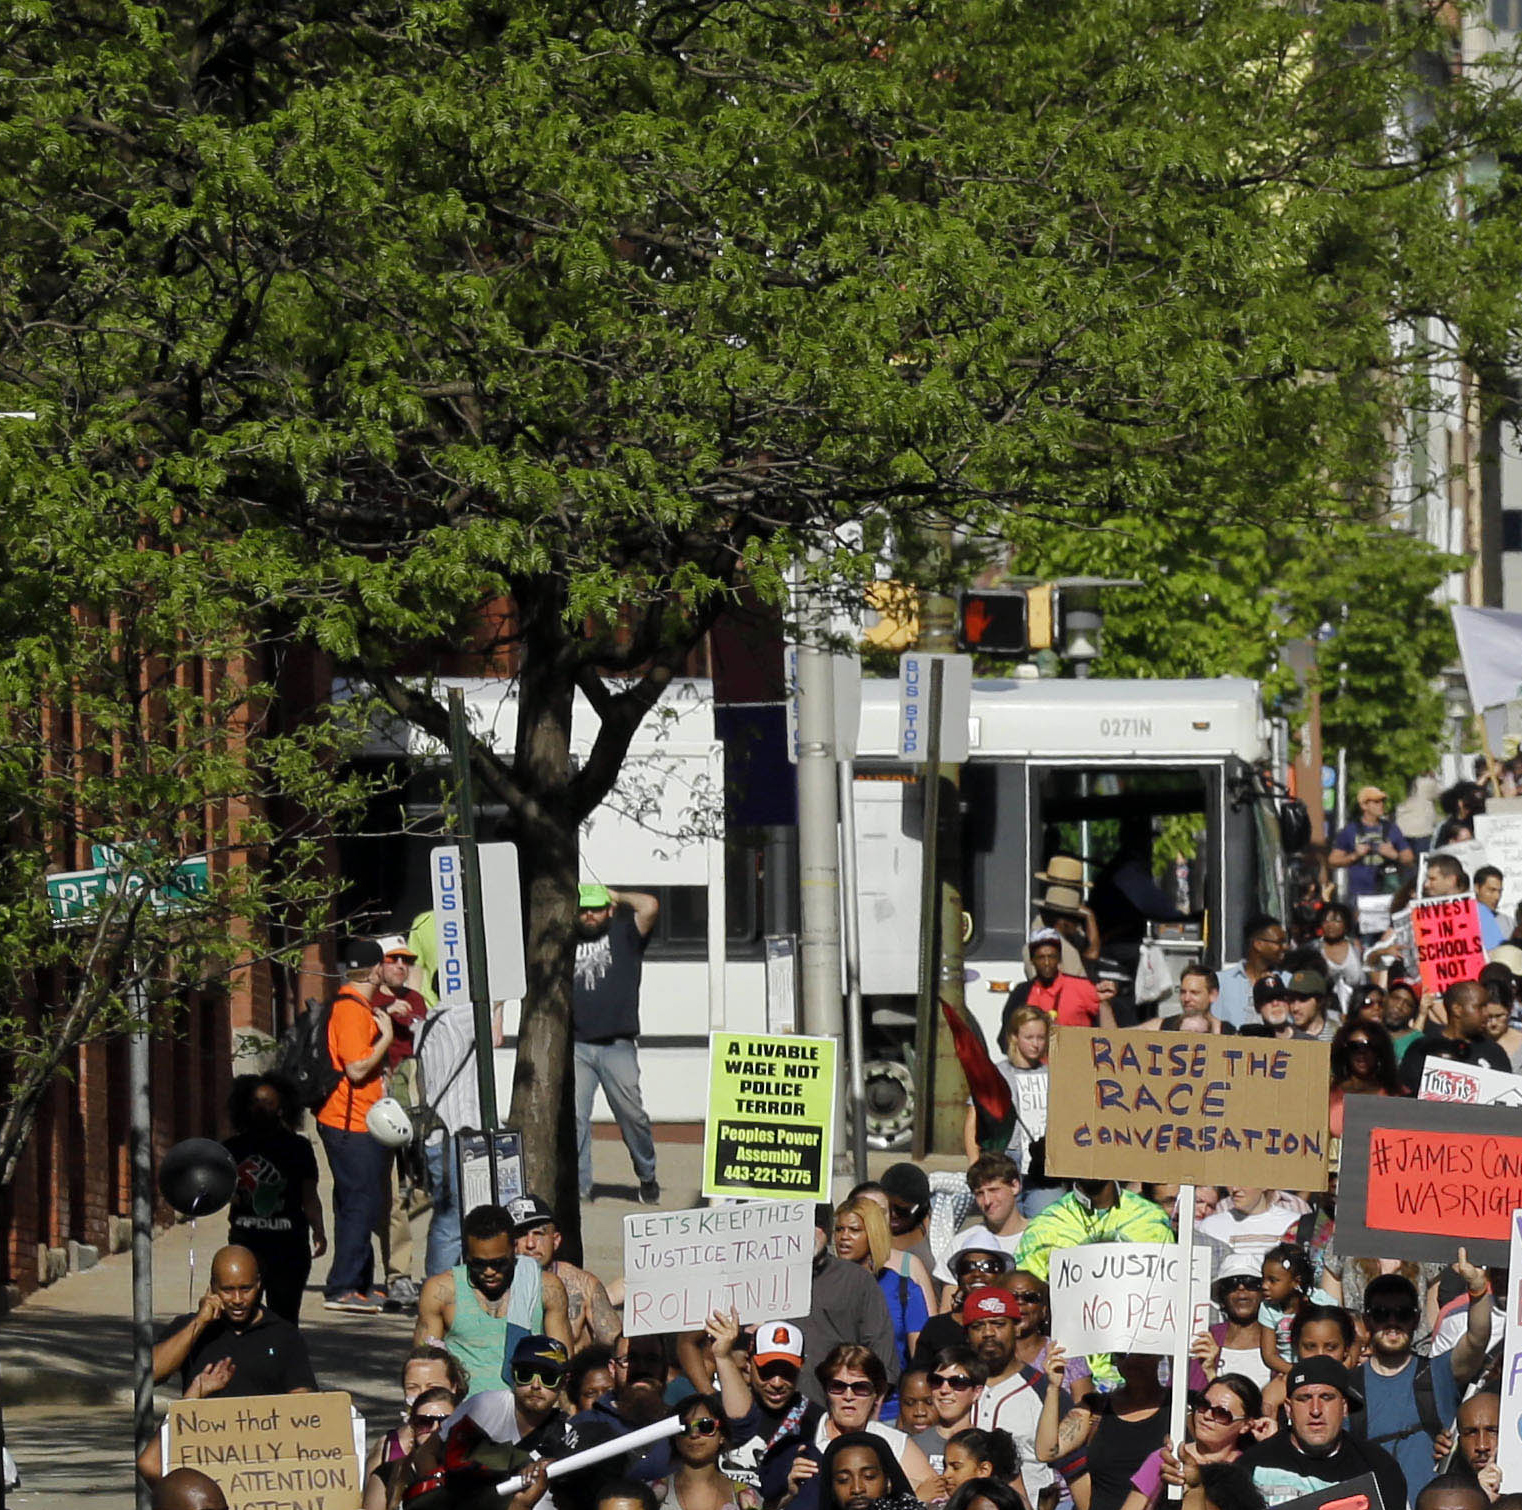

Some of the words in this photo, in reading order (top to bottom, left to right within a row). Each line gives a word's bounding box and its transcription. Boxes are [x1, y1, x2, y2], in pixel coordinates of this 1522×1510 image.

[904, 704, 918, 754] STOP
[1100, 717, 1152, 739] 0271N
[438, 854, 457, 914] BUS
[1416, 897, 1471, 921] INVEST
[438, 919, 463, 995] STOP
[1418, 936, 1482, 962] SCHOOLS
[1436, 961, 1467, 978] NOT
[747, 1042, 819, 1060] LIVABLE
[1091, 1036, 1207, 1079] RAISE
[1222, 1049, 1293, 1080] THE
[725, 1060, 777, 1077] WAGE
[783, 1063, 820, 1080] NOT
[740, 1079, 803, 1097] POLICE
[1094, 1079, 1232, 1118] RACE
[735, 1099, 806, 1117] TERROR
[720, 1124, 775, 1144] Peoples
[777, 1127, 820, 1147] Power
[735, 1145, 803, 1166] Assembly
[1371, 1136, 1474, 1177] #JAMES
[724, 1165, 811, 1185] 443-221-3775
[630, 1214, 691, 1239] LET'S
[754, 1202, 805, 1224] THIS
[634, 1243, 726, 1271] JUSTICE
[732, 1234, 802, 1264] TRAIN
[1057, 1258, 1083, 1290] NO
[1082, 1294, 1113, 1332] NO
[175, 1410, 227, 1437] Now
[235, 1407, 280, 1433] that
[290, 1414, 322, 1429] we
[180, 1441, 284, 1468] FINALLY
[296, 1443, 343, 1462] have
[230, 1467, 354, 1494] ATTENTION,
